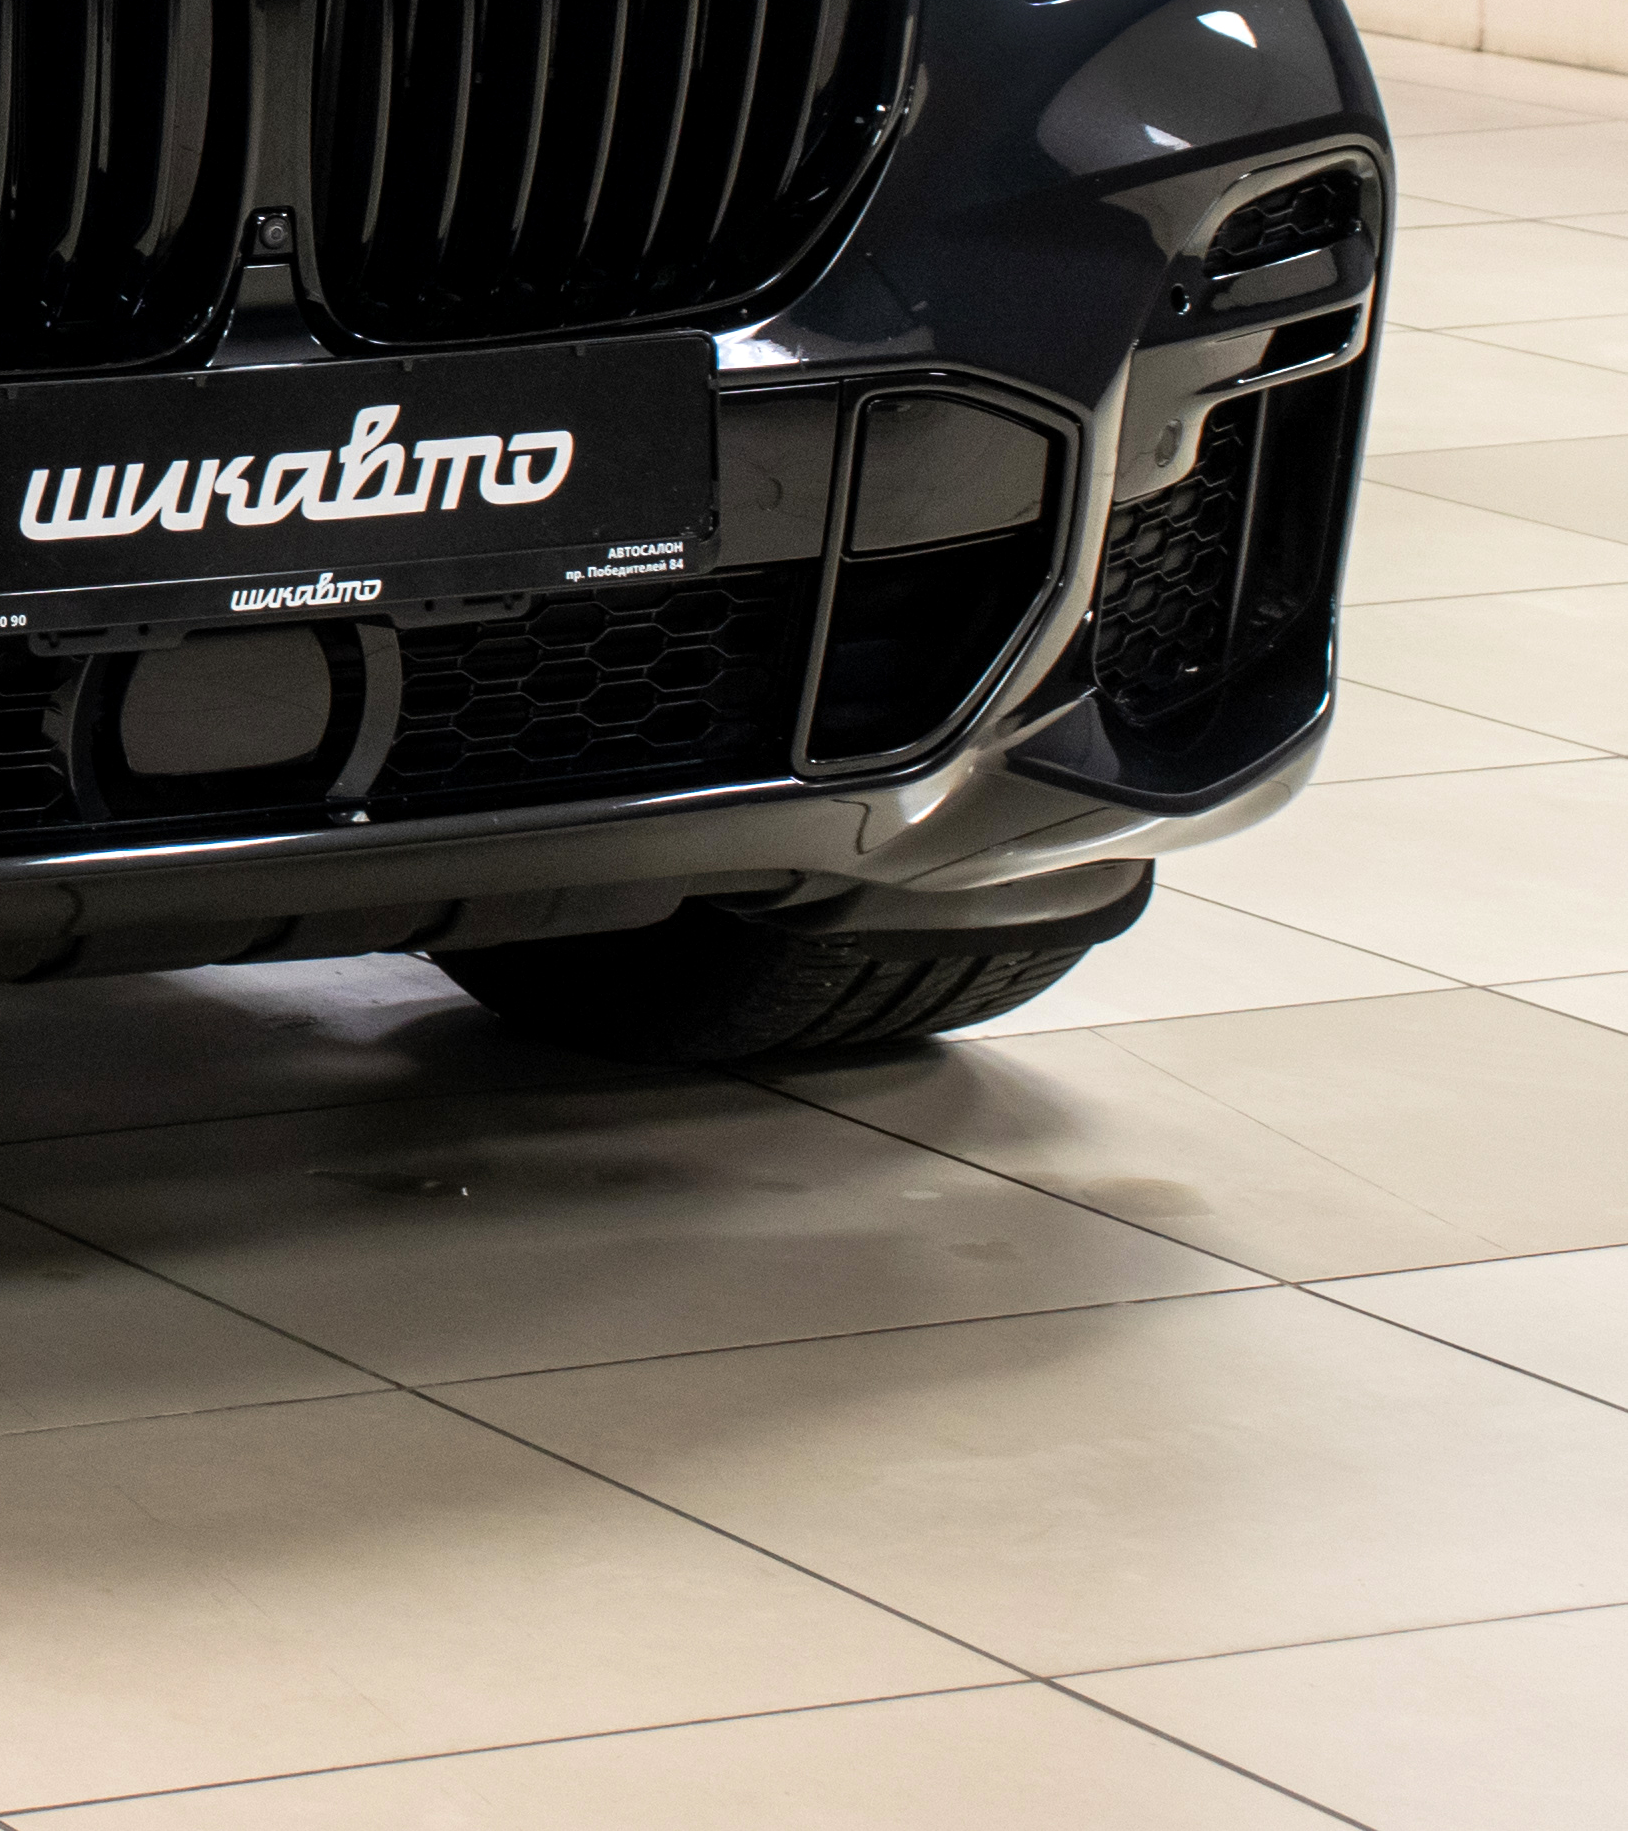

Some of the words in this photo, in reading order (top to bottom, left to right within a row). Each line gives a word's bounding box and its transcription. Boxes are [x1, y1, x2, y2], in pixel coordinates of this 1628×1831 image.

[19, 404, 574, 541] шикавто
[607, 541, 684, 559] АВТОСАЛОН
[565, 570, 586, 583] пр.
[587, 559, 667, 578] Победителей
[668, 558, 684, 571] 84
[230, 571, 382, 611] шикавто
[10, 614, 27, 628] 90
